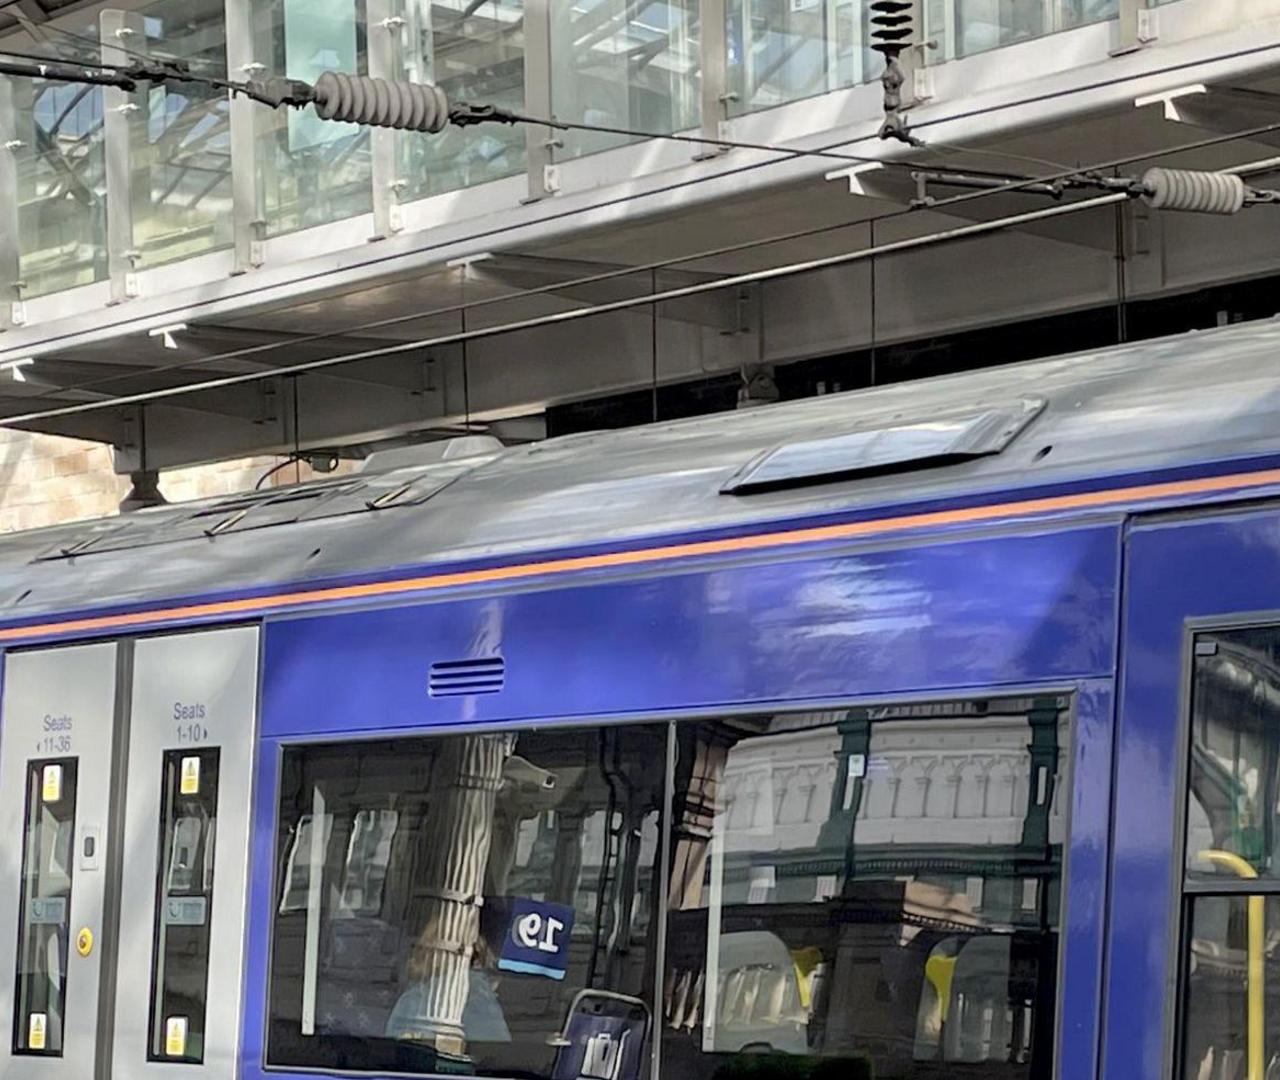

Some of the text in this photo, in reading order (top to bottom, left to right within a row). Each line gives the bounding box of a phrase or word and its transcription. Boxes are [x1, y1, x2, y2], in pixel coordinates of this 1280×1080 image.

[173, 701, 206, 720] Seats
[43, 714, 72, 731] Seats
[177, 724, 200, 743] 1-10
